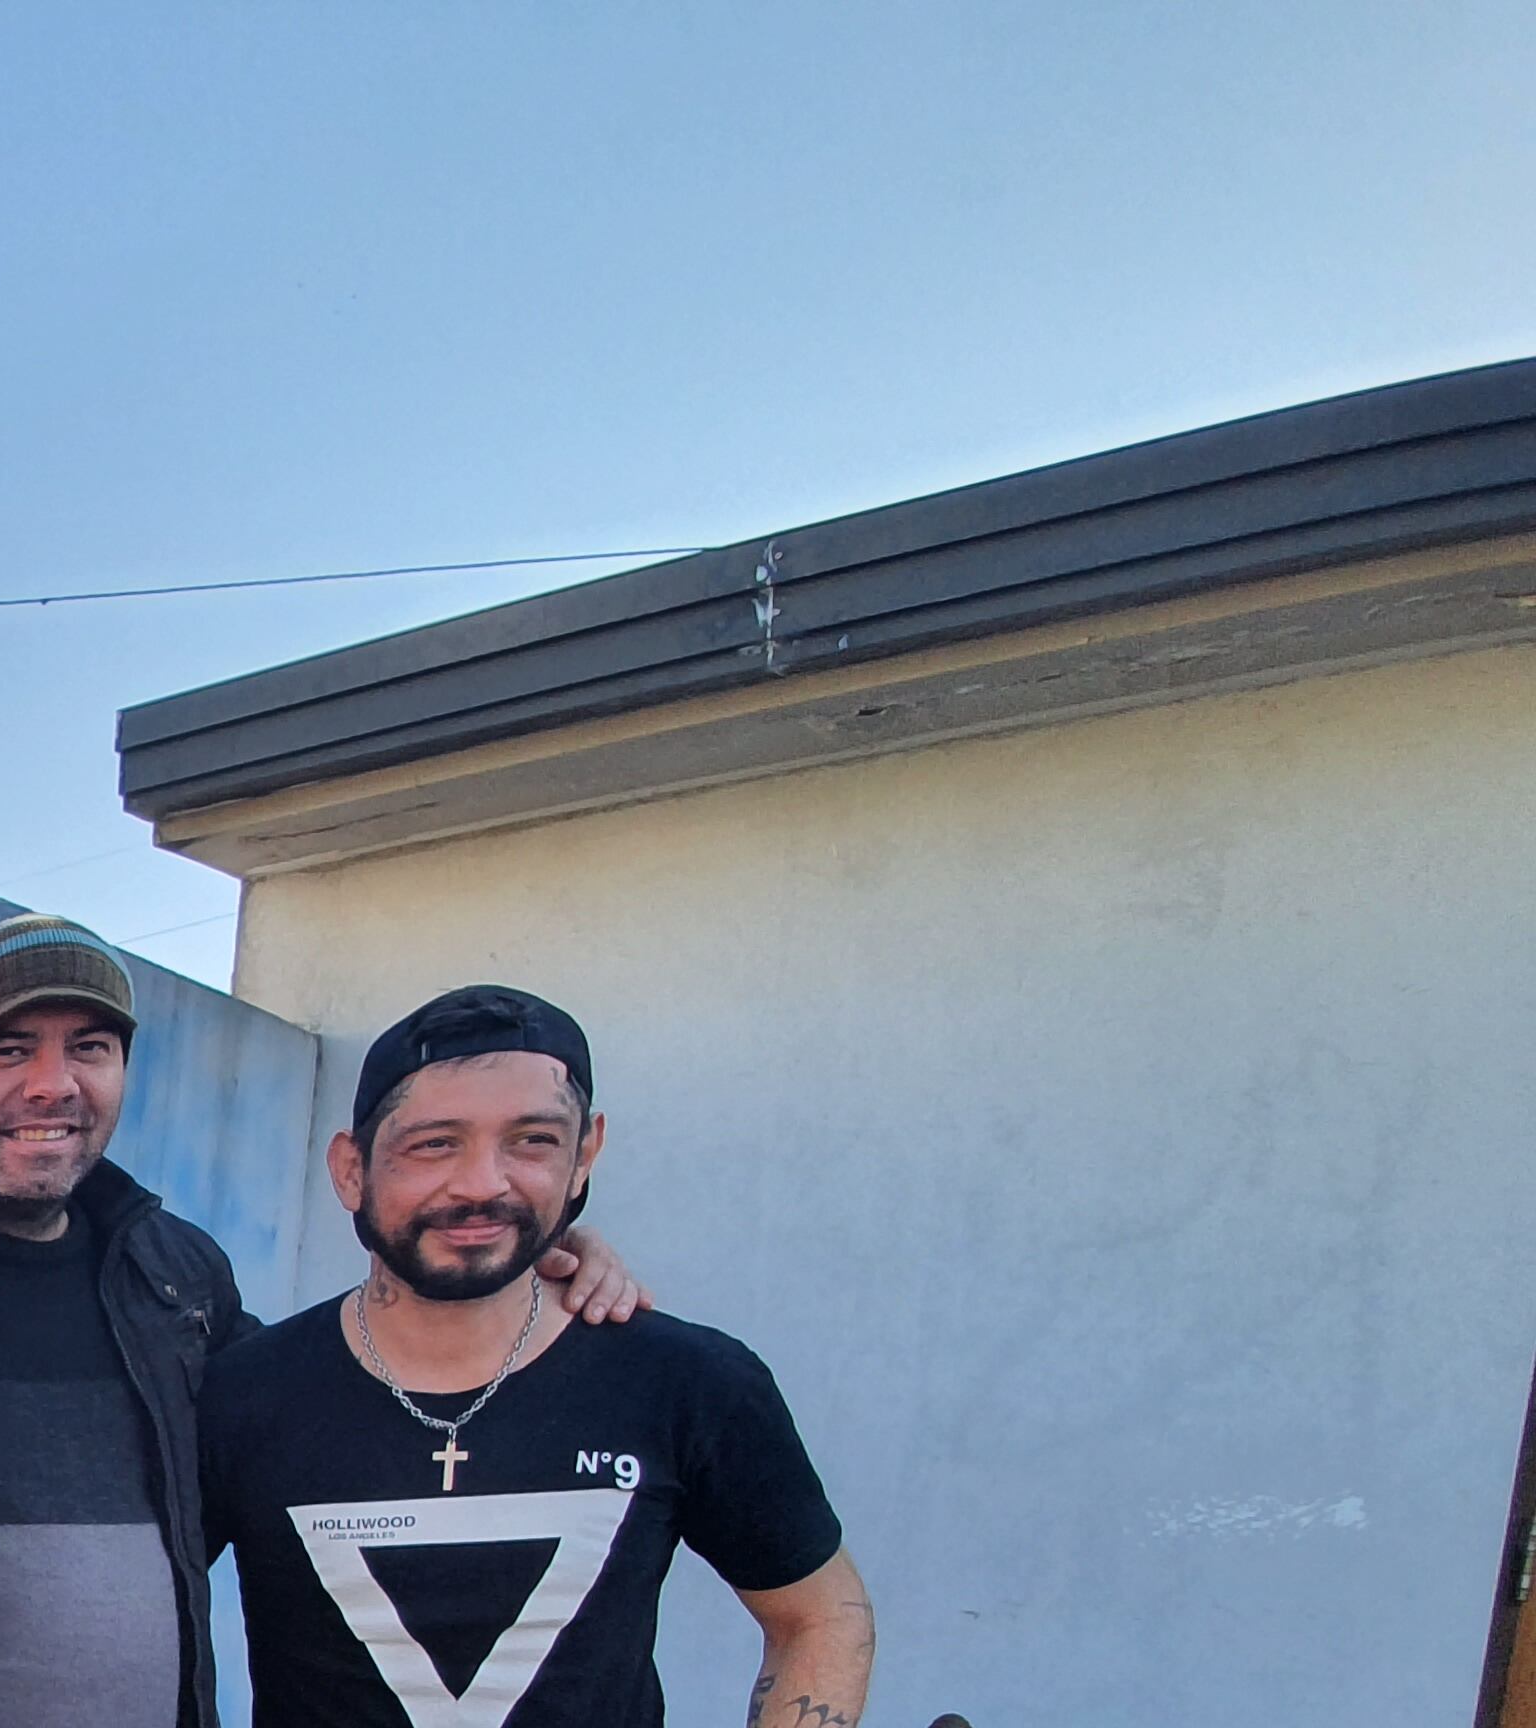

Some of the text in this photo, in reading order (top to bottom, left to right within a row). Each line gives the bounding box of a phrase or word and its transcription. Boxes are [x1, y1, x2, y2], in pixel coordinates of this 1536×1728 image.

[312, 1516, 416, 1531] HOLLIWOOD
[328, 1531, 396, 1540] LOS ANGELES
